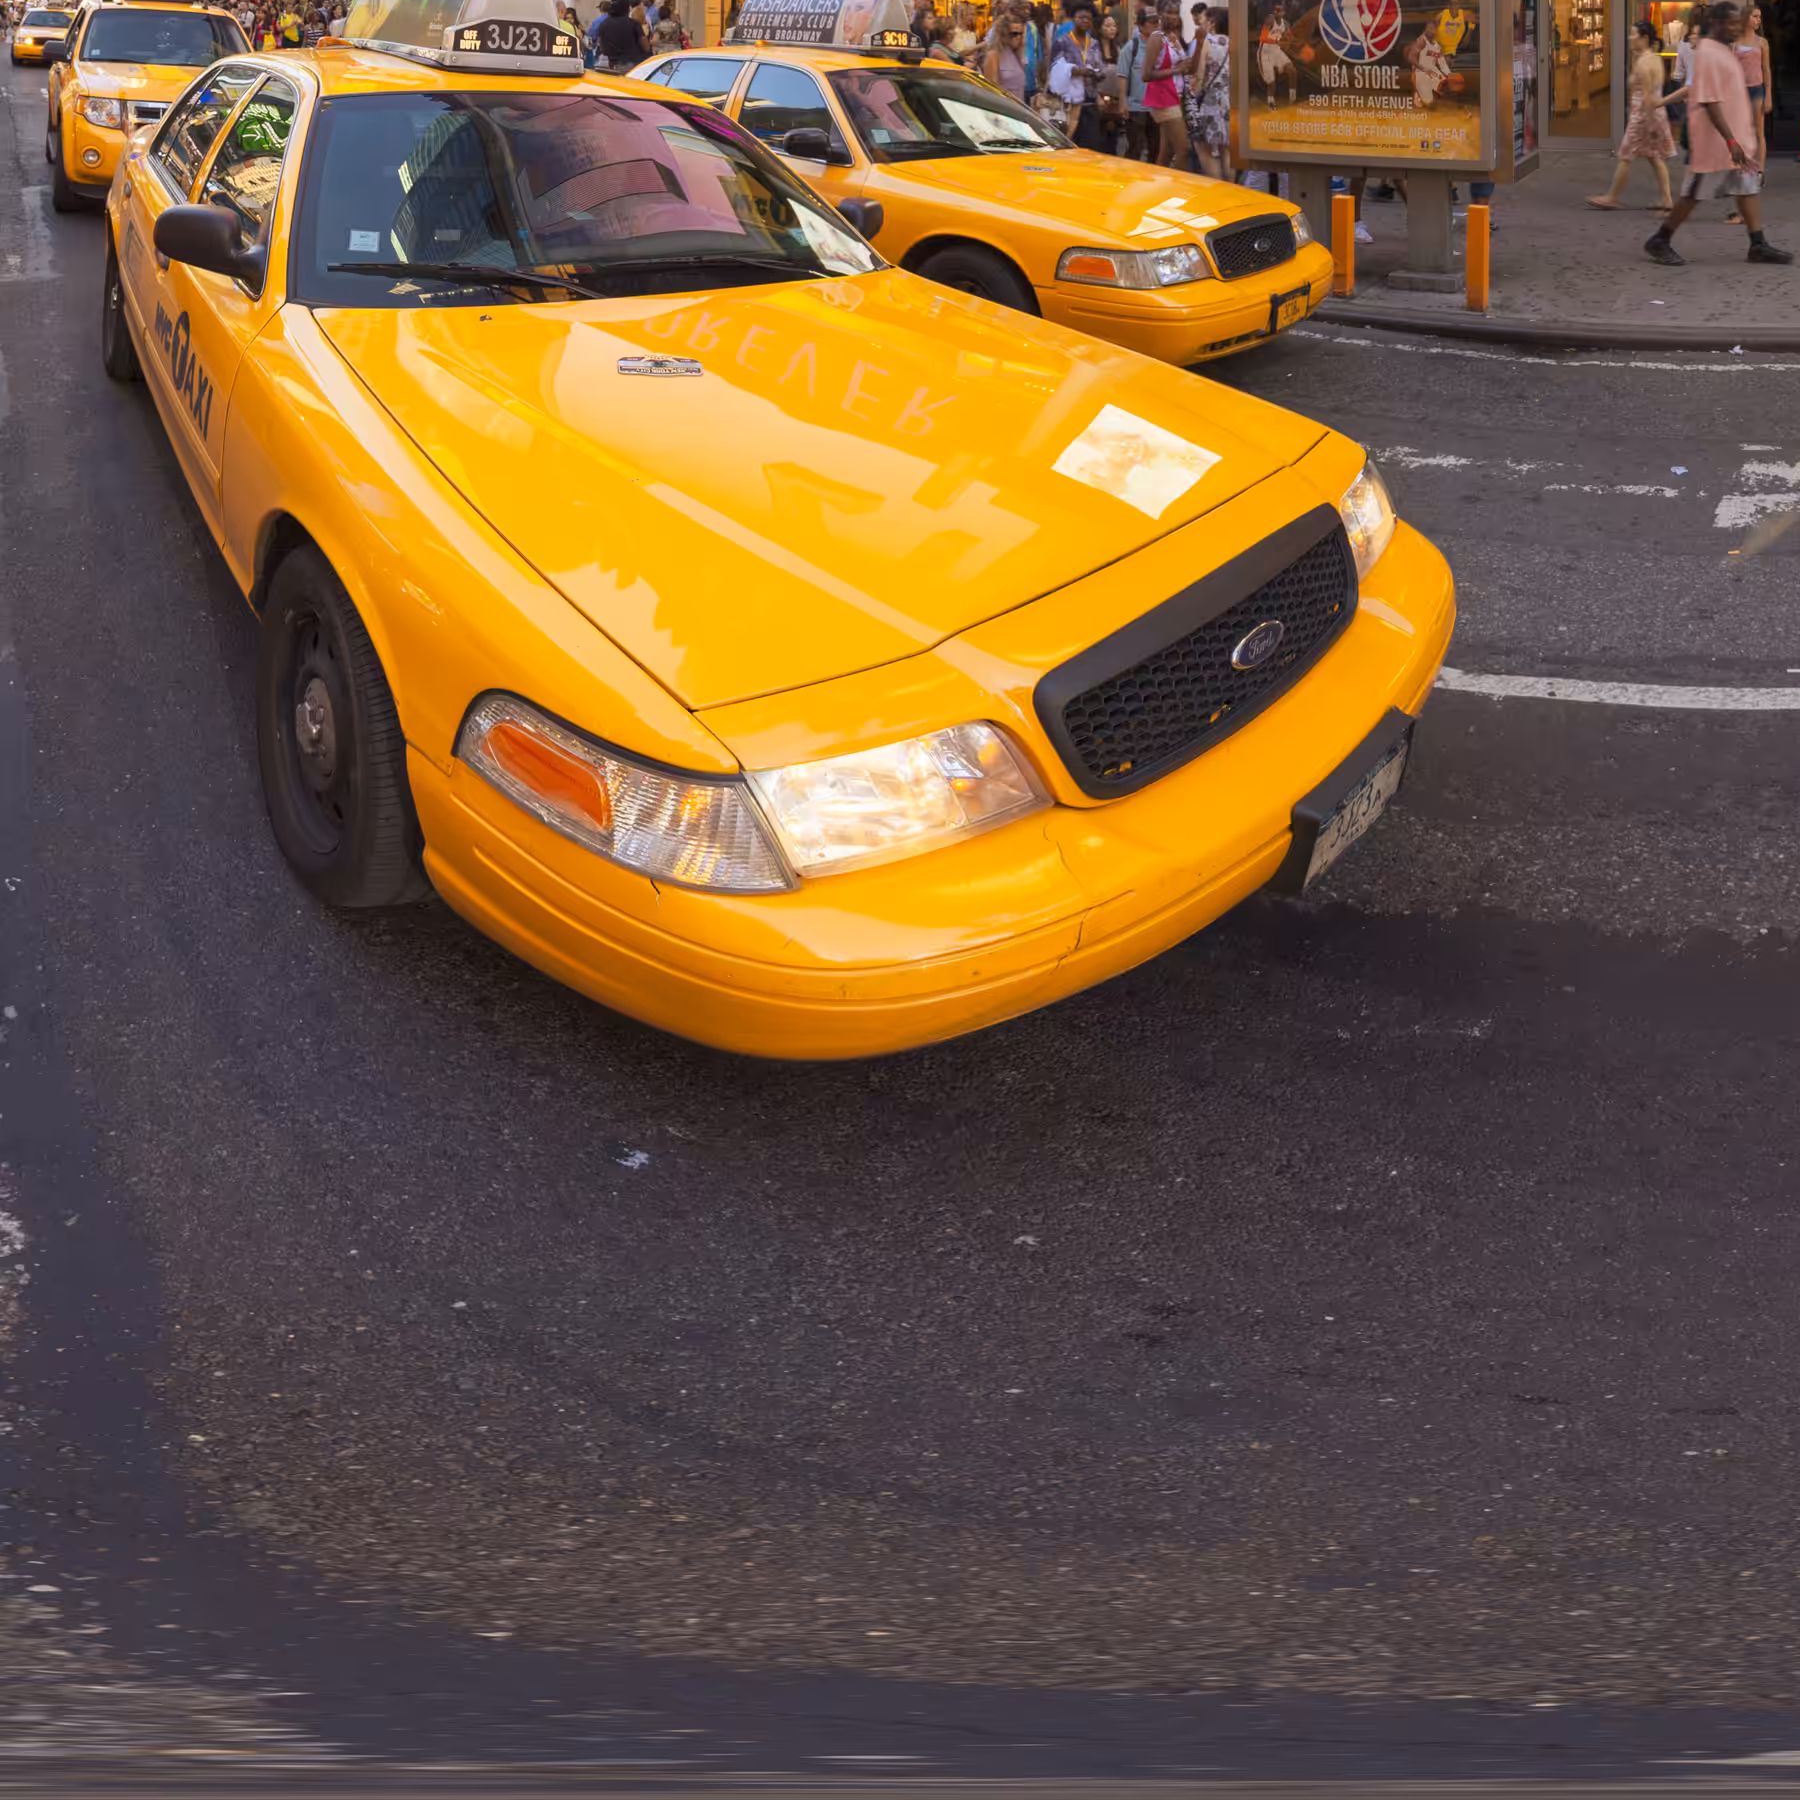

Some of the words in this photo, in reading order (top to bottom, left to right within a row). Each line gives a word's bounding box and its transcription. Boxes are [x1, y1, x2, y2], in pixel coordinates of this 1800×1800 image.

[463, 30, 479, 40] OFF
[486, 24, 542, 52] 3J23
[459, 40, 481, 51] DUTY
[1321, 64, 1351, 89] NBA
[1354, 64, 1401, 90] STORE
[1309, 94, 1330, 108] 590
[1332, 95, 1364, 109] FIFTH
[1367, 96, 1413, 110] AVENUE
